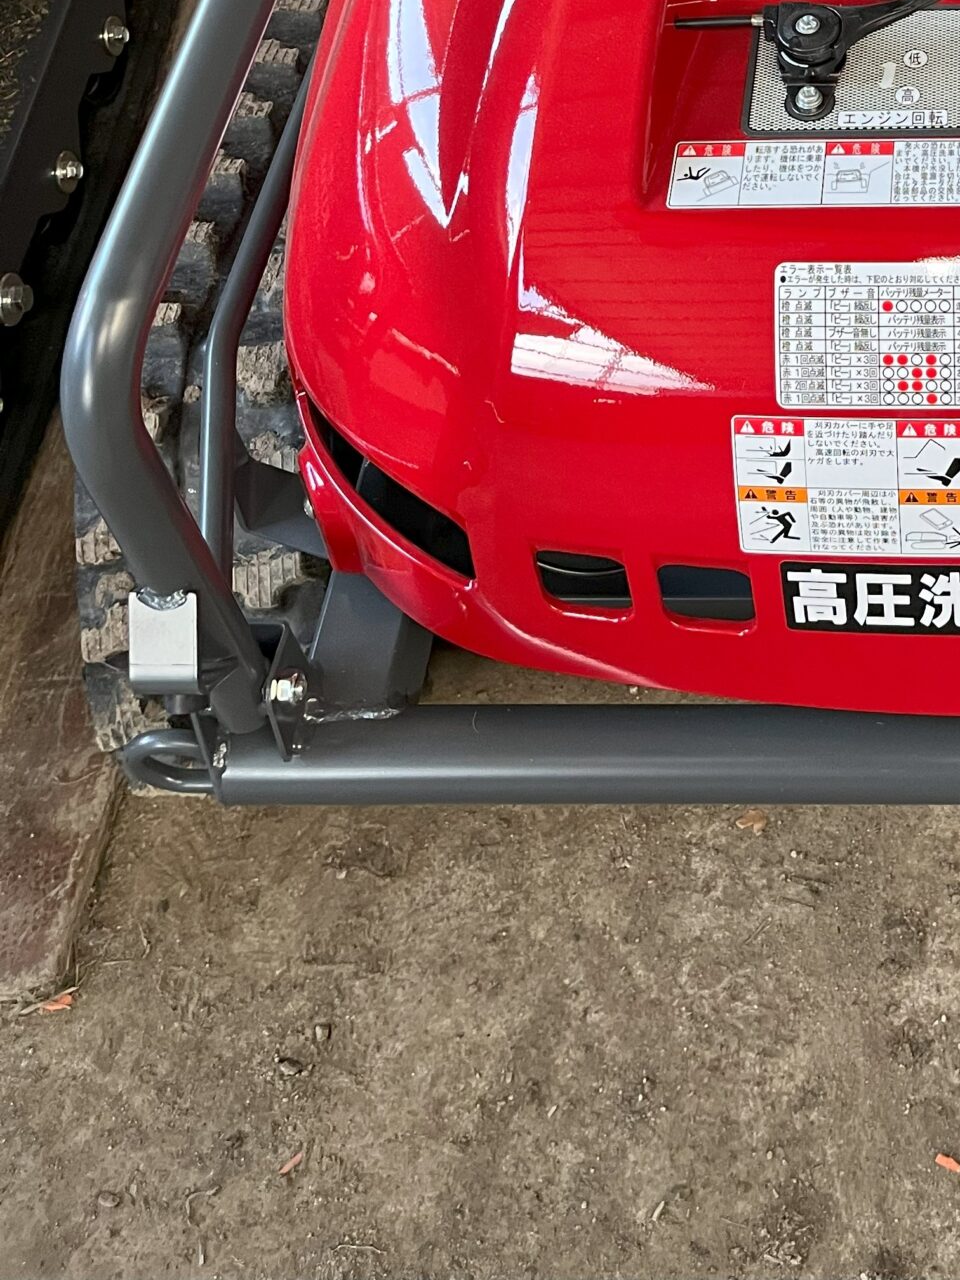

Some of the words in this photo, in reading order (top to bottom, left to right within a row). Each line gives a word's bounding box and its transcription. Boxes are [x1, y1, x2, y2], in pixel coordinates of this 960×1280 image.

[907, 51, 922, 65] 低
[901, 88, 915, 103] 高
[843, 111, 944, 125] エンジン回転
[704, 144, 732, 156] 危険
[852, 143, 880, 155] 危険
[780, 264, 852, 275] エラー表示一覧表
[784, 288, 822, 299] ランプ
[829, 288, 876, 299] ブザー音
[880, 288, 952, 298] バッテリ残量メーター
[761, 421, 795, 434] 危険
[924, 423, 956, 436] 危険
[766, 489, 797, 501] 警告
[926, 492, 957, 503] 警告
